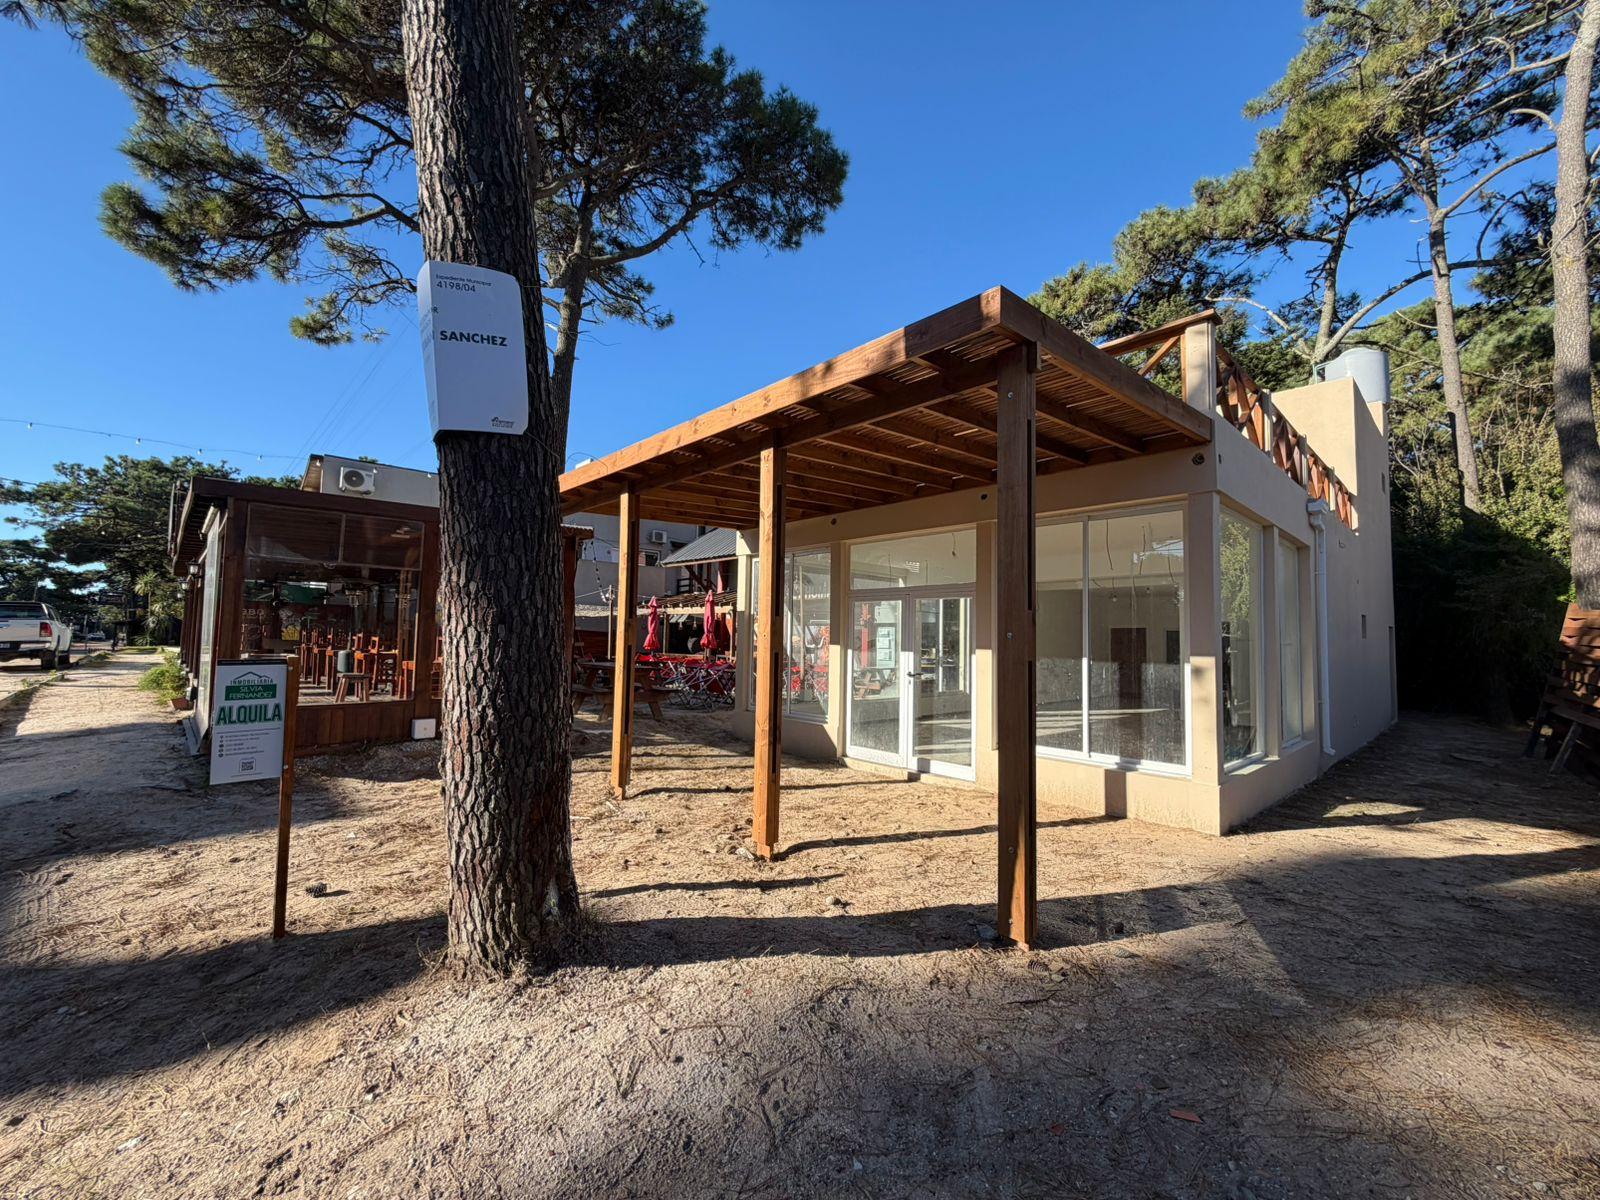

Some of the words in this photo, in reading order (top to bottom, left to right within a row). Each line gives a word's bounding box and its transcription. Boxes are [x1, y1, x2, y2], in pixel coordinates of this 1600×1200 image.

[436, 281, 476, 292] 4198/04
[440, 330, 508, 347] SANCHEZ
[239, 685, 264, 693] SILVIA
[229, 691, 273, 699] FERNANDEZ
[215, 702, 283, 726] ALQUILA
